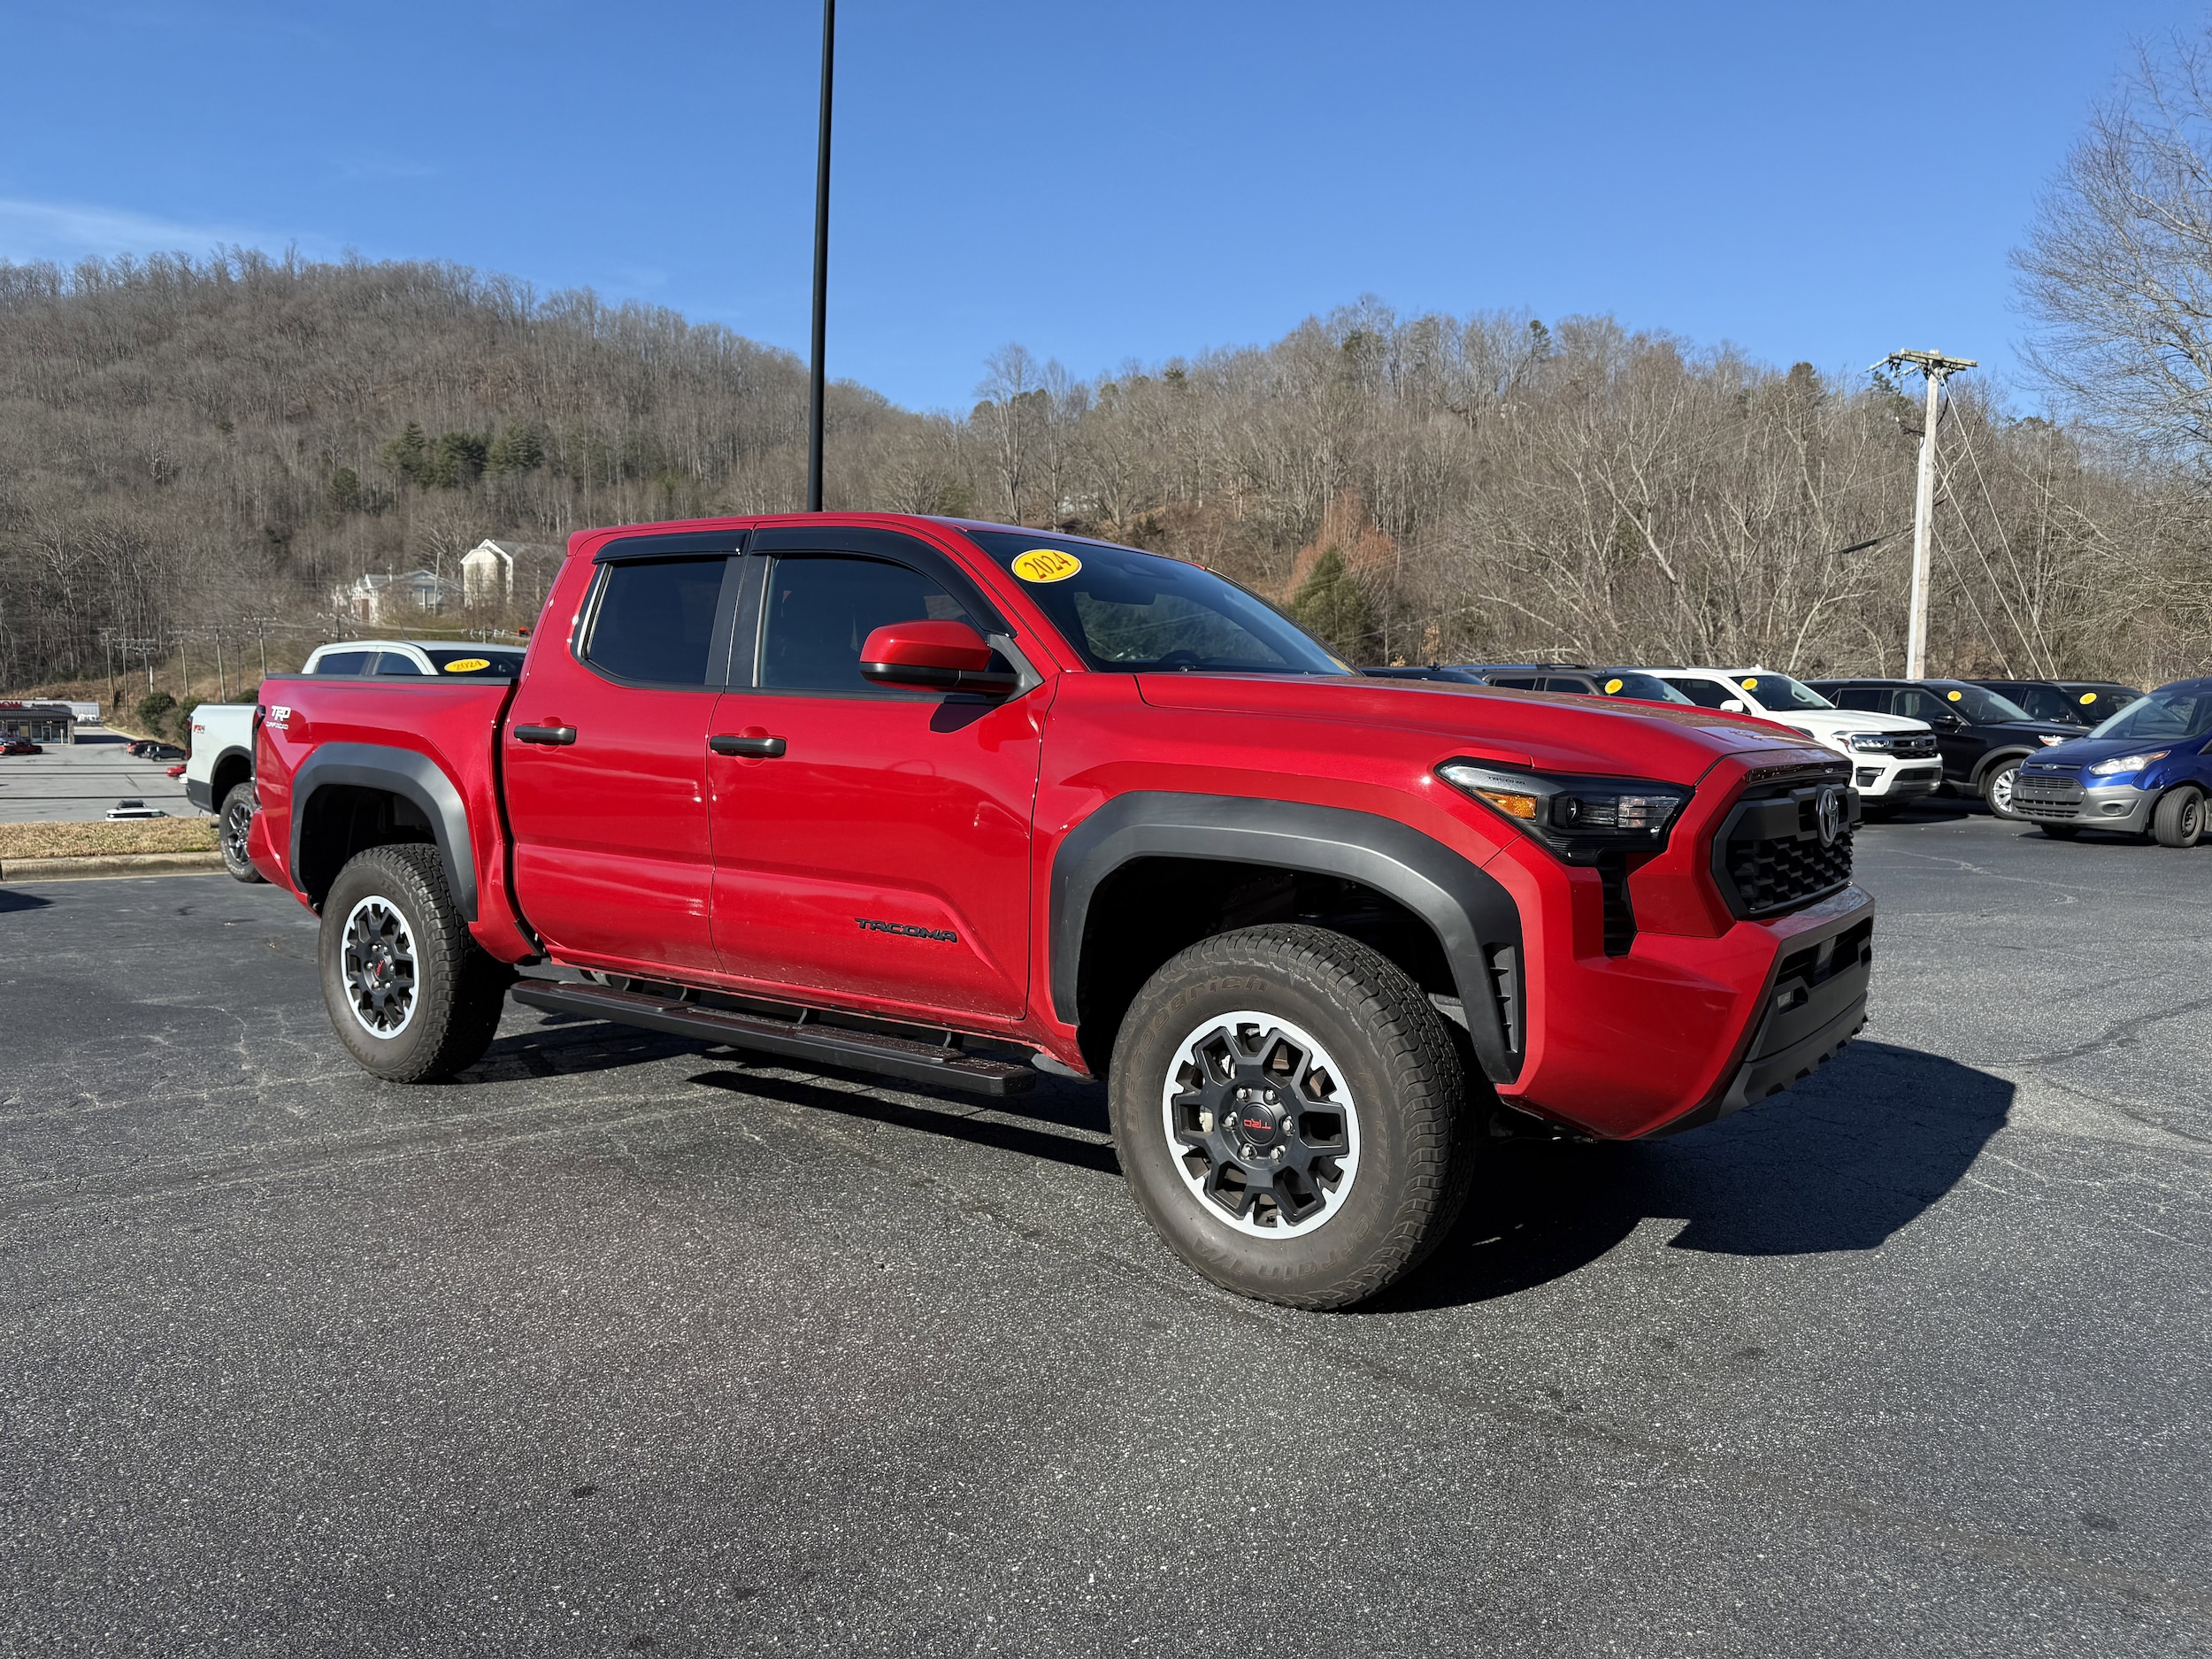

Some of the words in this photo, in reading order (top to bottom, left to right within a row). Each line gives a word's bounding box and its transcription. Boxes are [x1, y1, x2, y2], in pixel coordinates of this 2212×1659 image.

[1024, 551, 1071, 580] 2024
[0, 700, 23, 710] OW
[271, 705, 292, 721] TRD
[854, 918, 958, 944] TACOMA
[1125, 974, 1269, 1134] BFGoodrich
[1243, 1118, 1271, 1130] TRD
